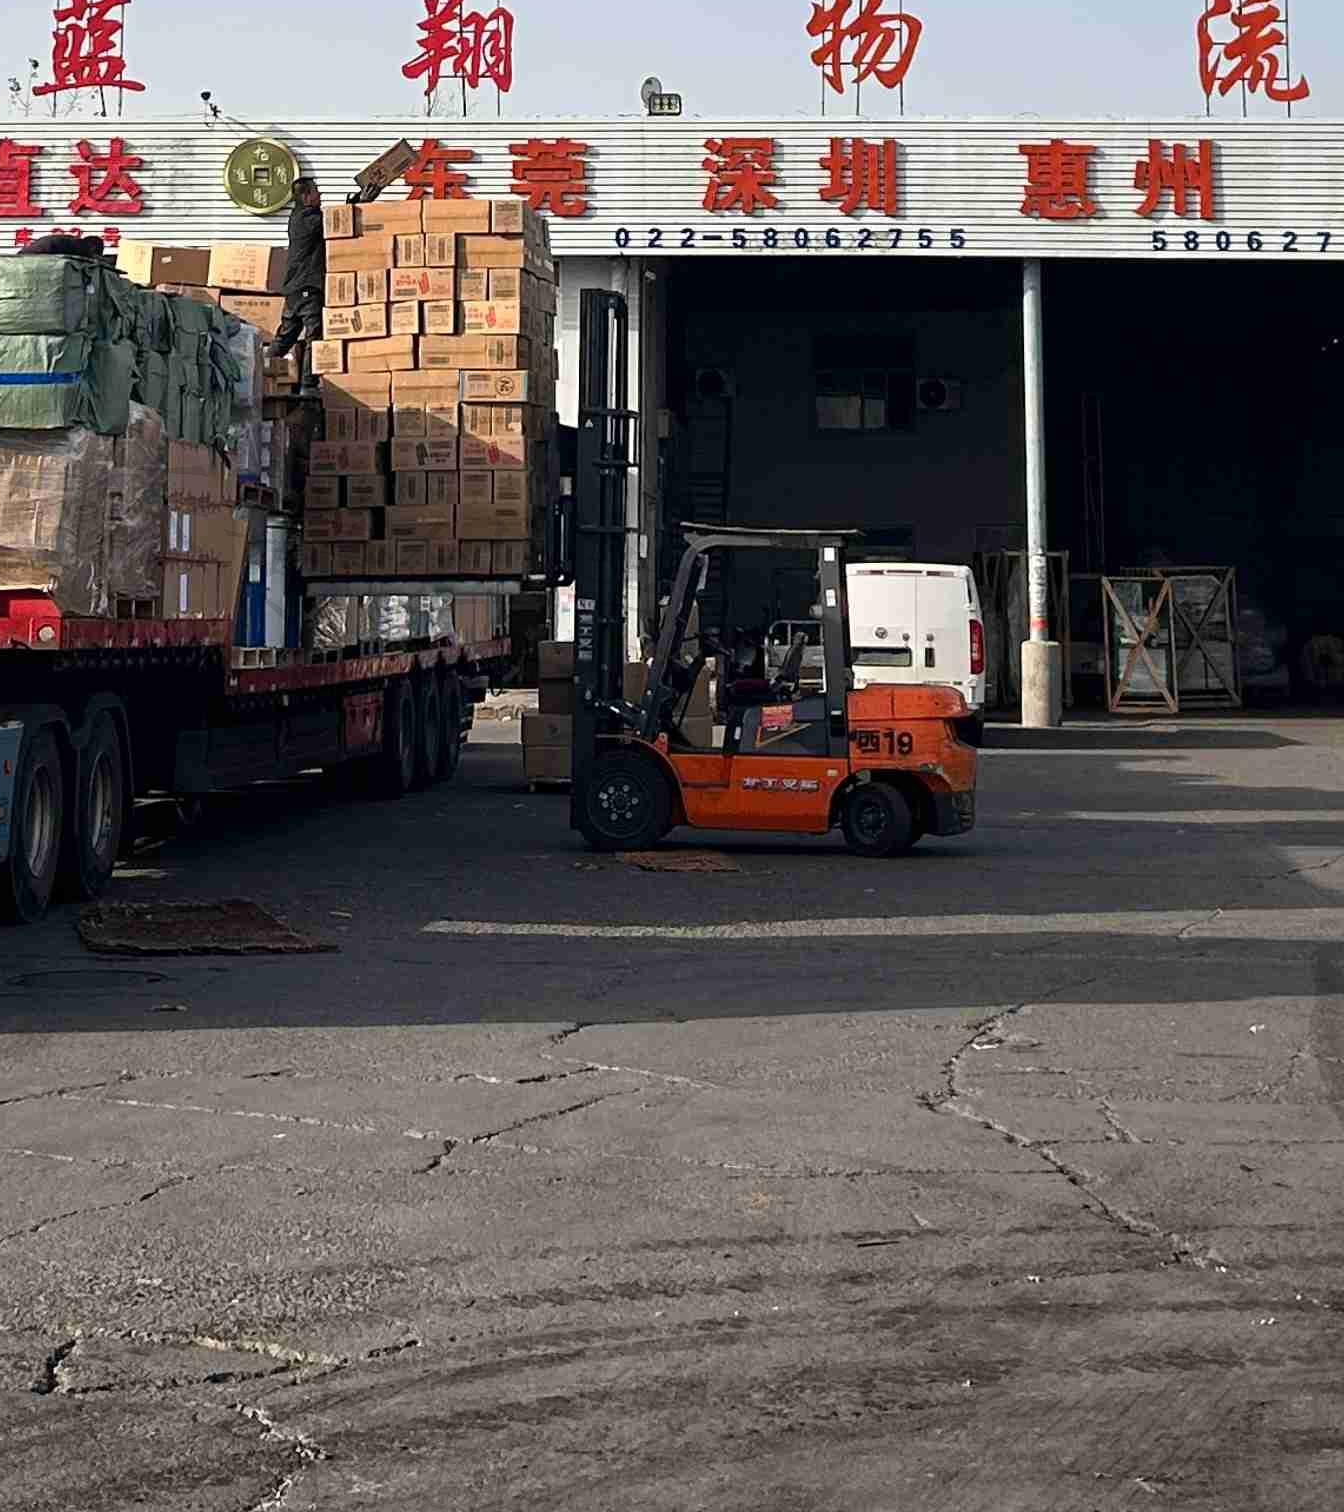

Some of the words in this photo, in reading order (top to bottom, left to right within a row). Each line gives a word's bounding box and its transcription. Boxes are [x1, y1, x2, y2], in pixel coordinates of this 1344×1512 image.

[404, 137, 588, 217] 东莞
[701, 137, 898, 216] 深圳
[1018, 139, 1215, 221] 惠州
[614, 227, 966, 249] 022-58062755
